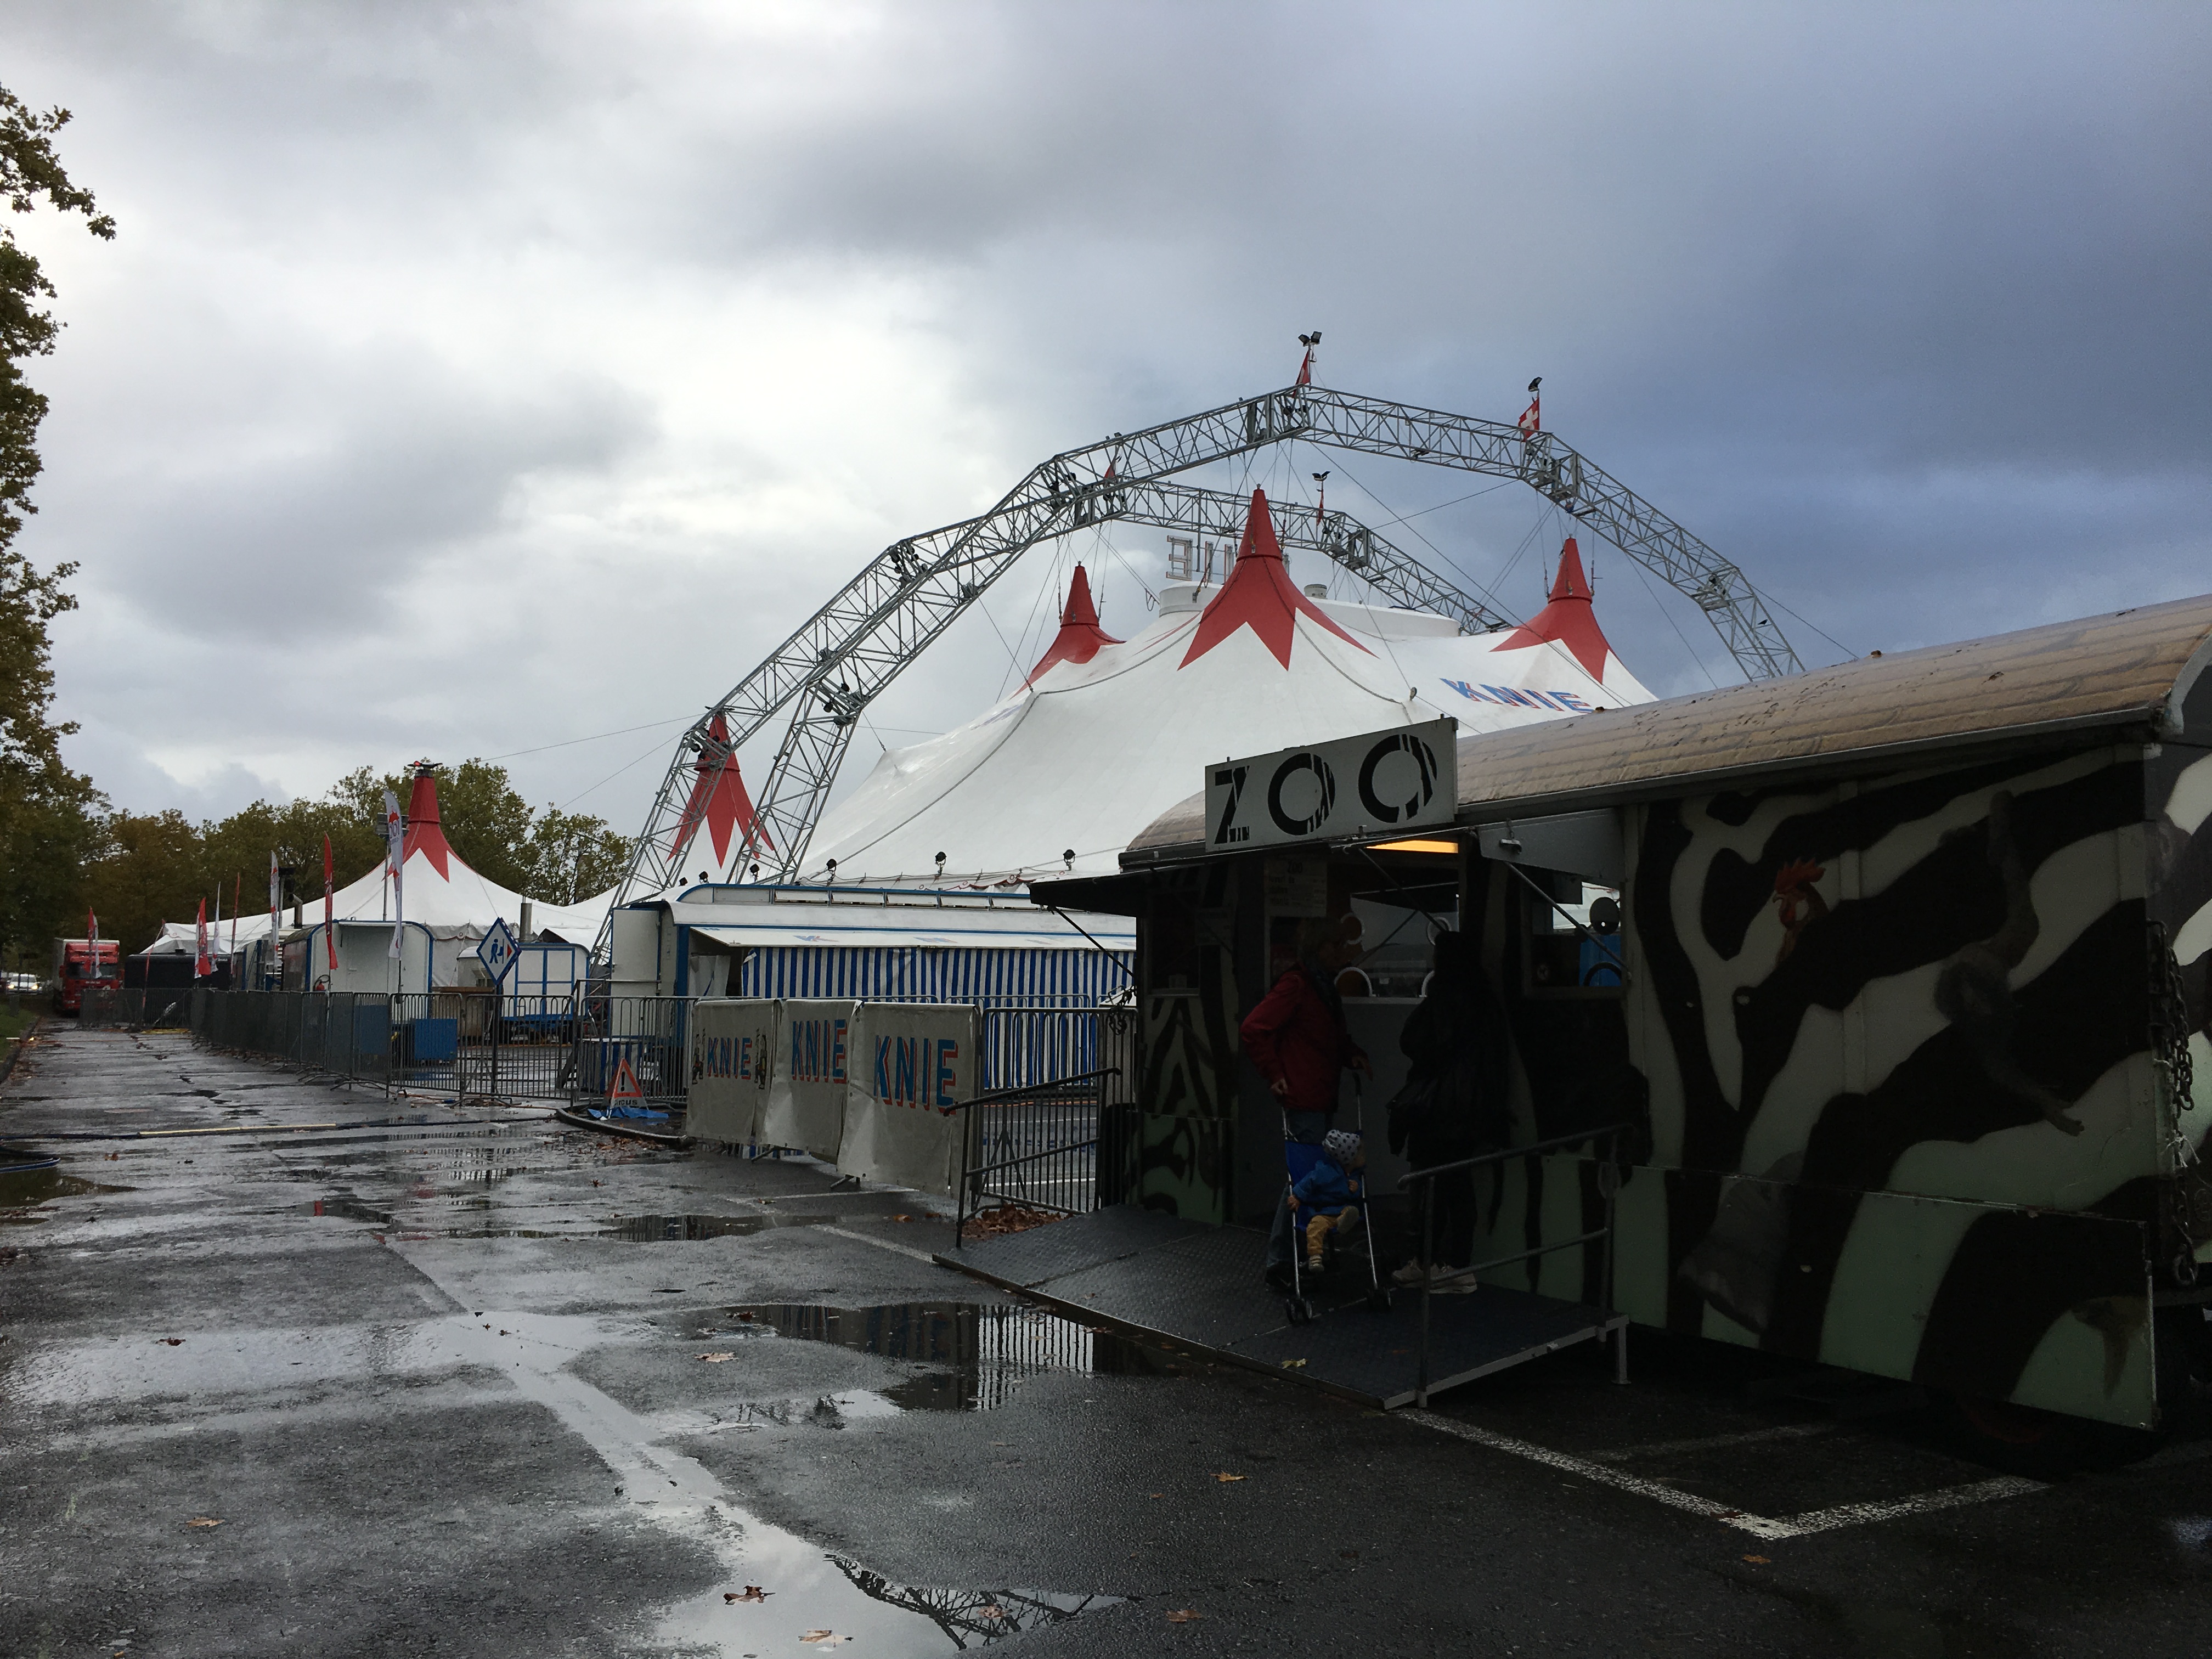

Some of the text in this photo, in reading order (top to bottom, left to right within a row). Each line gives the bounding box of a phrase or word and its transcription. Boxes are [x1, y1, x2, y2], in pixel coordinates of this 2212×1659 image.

[1439, 678, 1595, 713] KNIE
[1214, 734, 1437, 845] ZOO
[707, 1037, 752, 1080] KNIE
[792, 1018, 848, 1084] KNIE
[874, 1035, 959, 1115] KNIE
